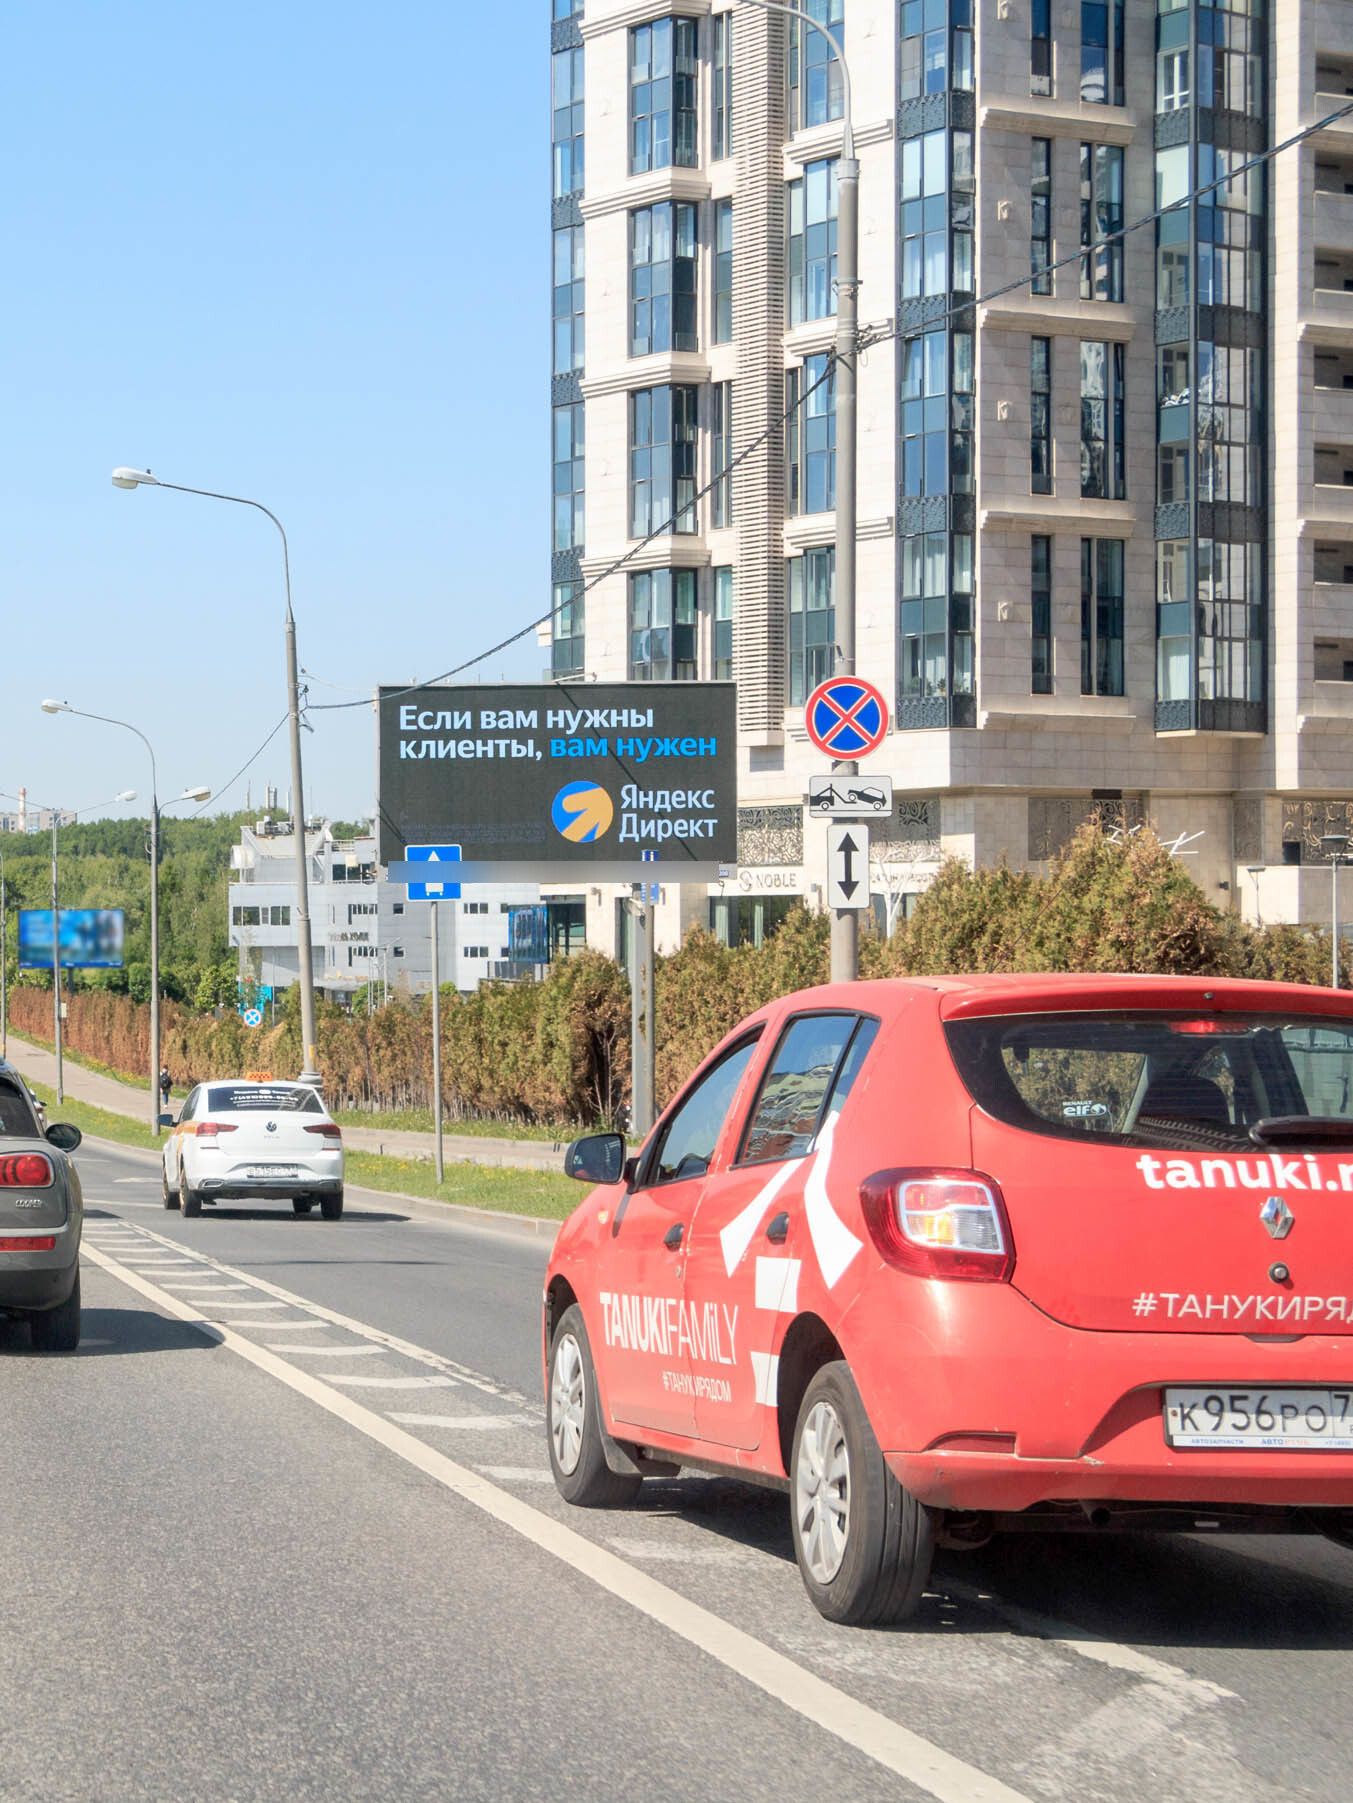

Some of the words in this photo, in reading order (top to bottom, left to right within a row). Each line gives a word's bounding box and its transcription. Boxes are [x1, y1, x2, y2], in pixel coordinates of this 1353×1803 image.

[399, 705, 472, 731] Если
[480, 709, 538, 730] вам
[547, 709, 654, 735] нужны
[400, 738, 542, 761] клиенты,
[551, 737, 608, 758] вам
[617, 737, 717, 763] нужен
[620, 784, 715, 813] Яндекс
[619, 813, 718, 843] Директ
[756, 873, 797, 888] NOBLE
[1132, 1292, 1353, 1324] #ТАНУКИРЯ
[1179, 1394, 1327, 1433] К956РО
